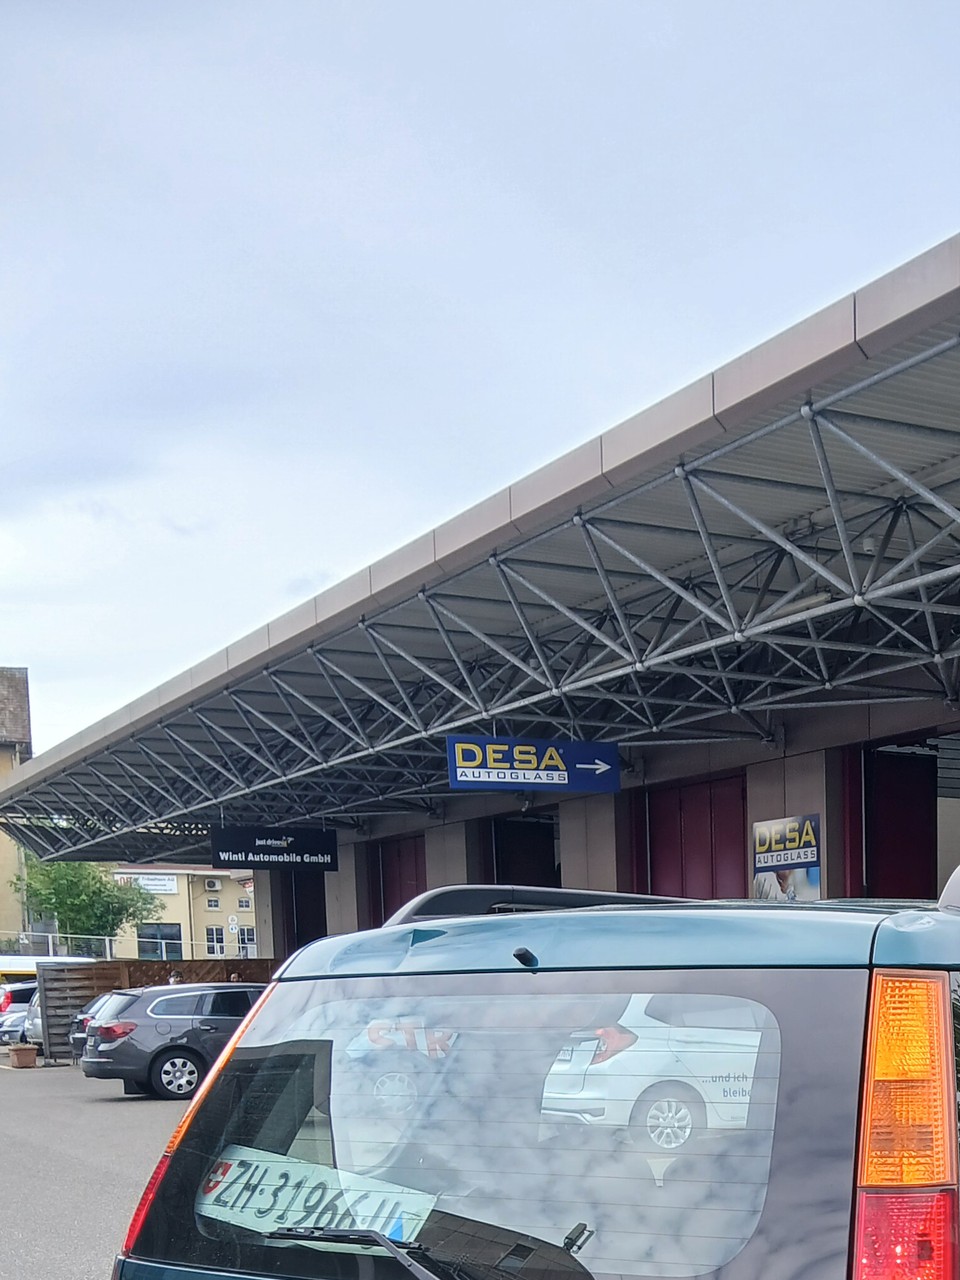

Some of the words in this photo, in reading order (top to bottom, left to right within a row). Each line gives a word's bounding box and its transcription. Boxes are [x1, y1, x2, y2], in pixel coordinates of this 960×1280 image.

[454, 743, 567, 770] DESA
[459, 770, 567, 782] AUTOGLASS
[755, 819, 817, 853] DESA
[219, 851, 246, 862] Winti
[247, 852, 301, 863] Automobile
[303, 853, 331, 863] GmbH
[756, 849, 816, 866] AUTOGLASS
[733, 1072, 748, 1082] ich
